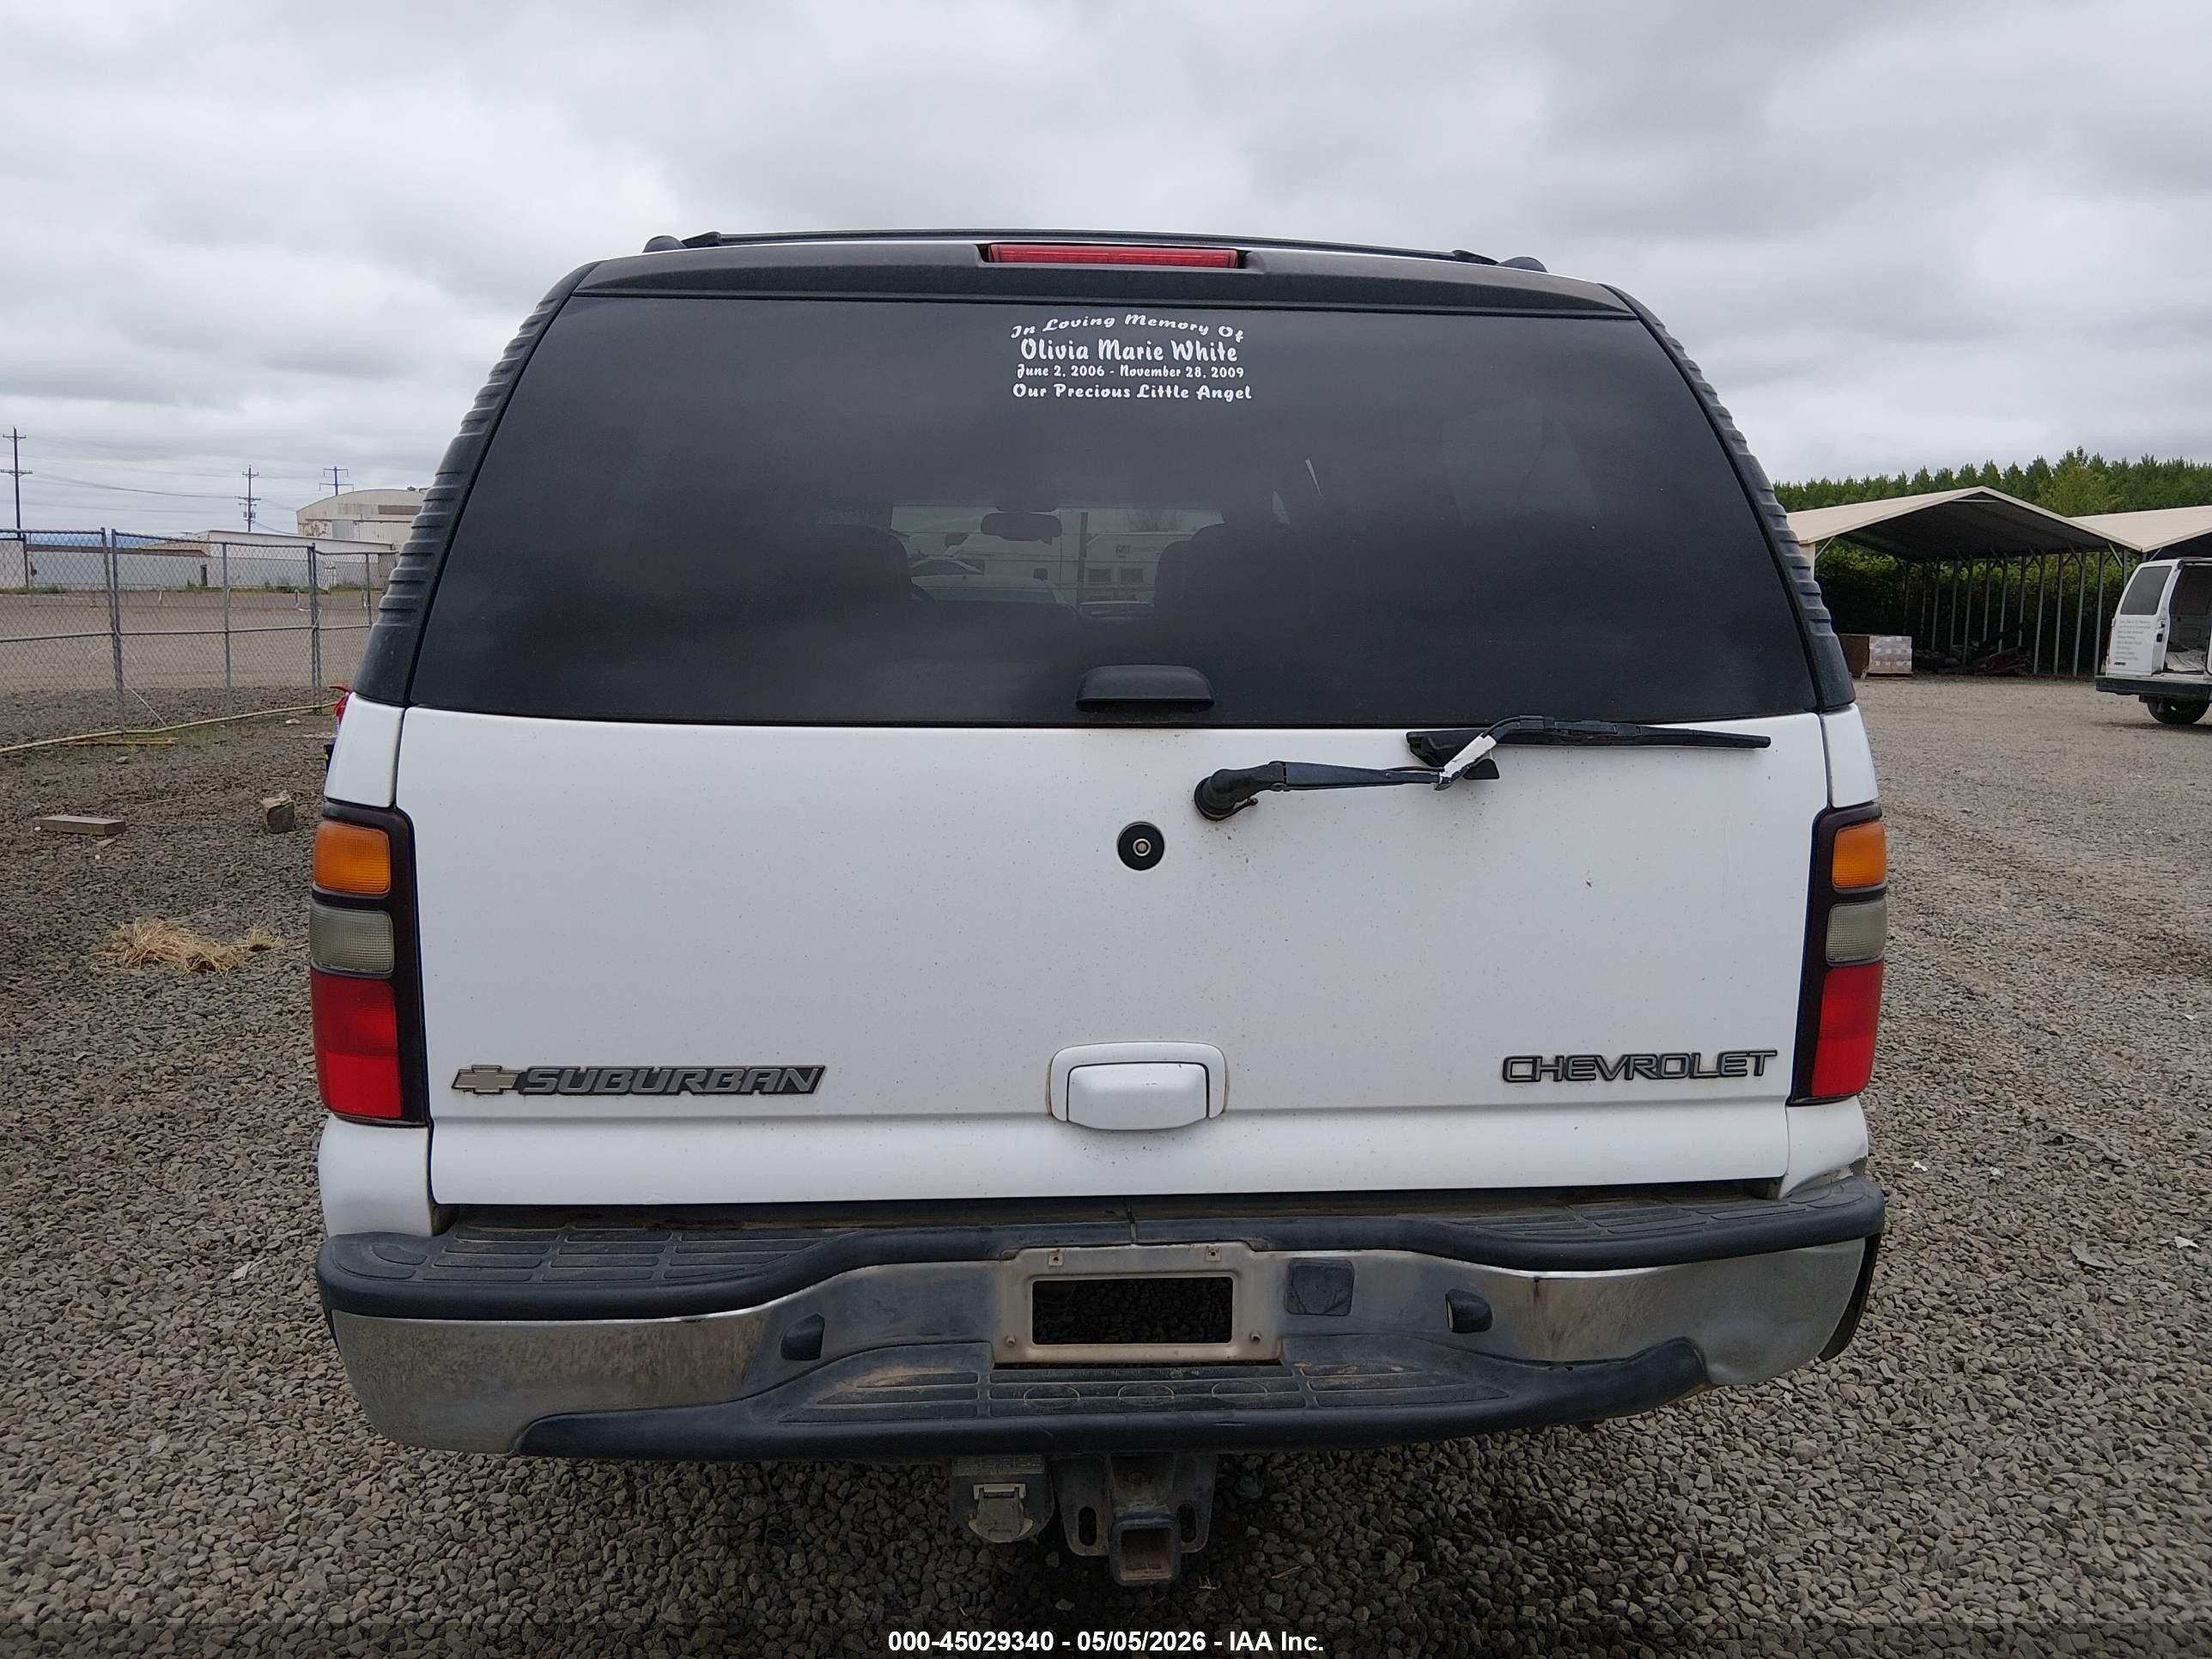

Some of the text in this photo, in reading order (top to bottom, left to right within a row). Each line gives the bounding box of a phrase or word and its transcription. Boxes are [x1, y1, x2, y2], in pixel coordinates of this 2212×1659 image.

[1011, 314, 1243, 343] In Loving Memory Of
[1021, 338, 1237, 362] Olivia Marie White
[1017, 363, 1049, 379] June
[1071, 365, 1105, 377] 2006
[1120, 364, 1182, 378] November
[1211, 367, 1244, 379] 2009
[1012, 383, 1252, 403] Our Precious Little Angel
[1503, 1049, 1778, 1082] CHEVROLET
[520, 1066, 825, 1095] SUBURBAN
